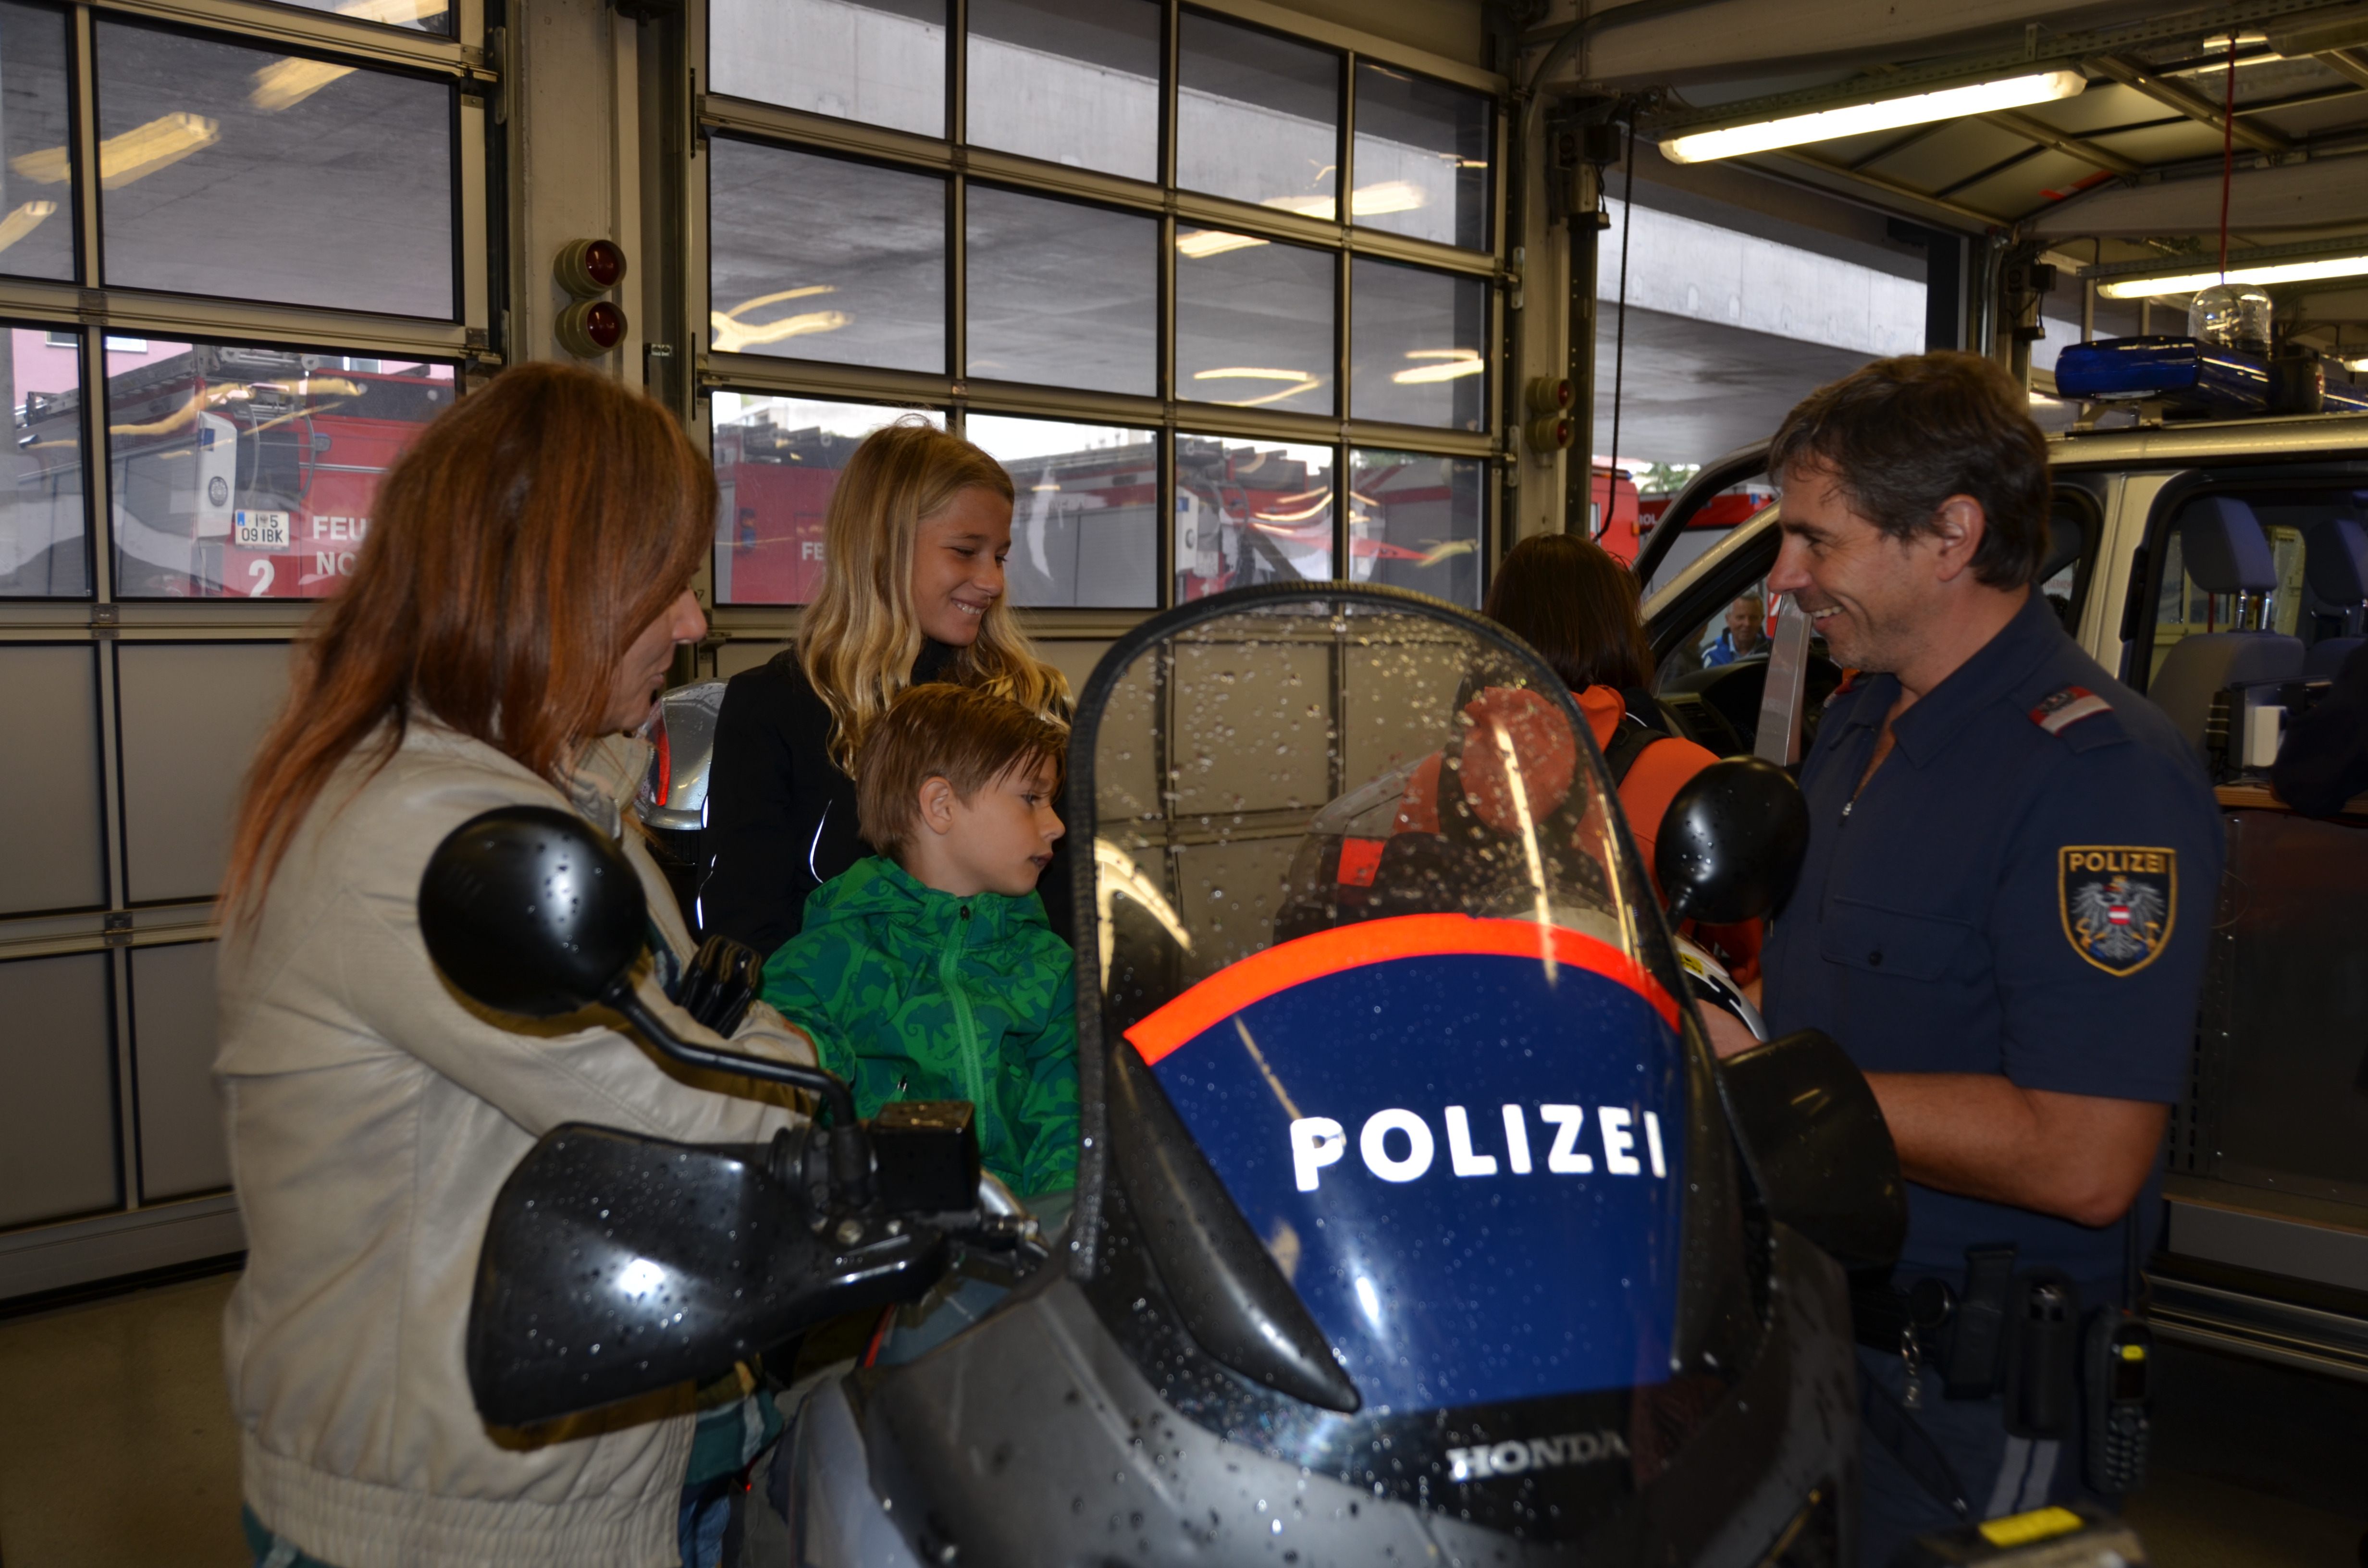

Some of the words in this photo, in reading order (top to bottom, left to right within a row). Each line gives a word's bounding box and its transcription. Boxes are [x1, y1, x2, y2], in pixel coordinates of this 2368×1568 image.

[270, 514, 279, 528] 5
[313, 515, 367, 542] FEU
[317, 551, 357, 576] NO
[802, 541, 824, 561] FE
[249, 559, 274, 597] 2
[2069, 852, 2166, 873] POLIZEI
[1290, 1104, 1666, 1192] POLIZEI
[1445, 1430, 1630, 1482] HONDA
